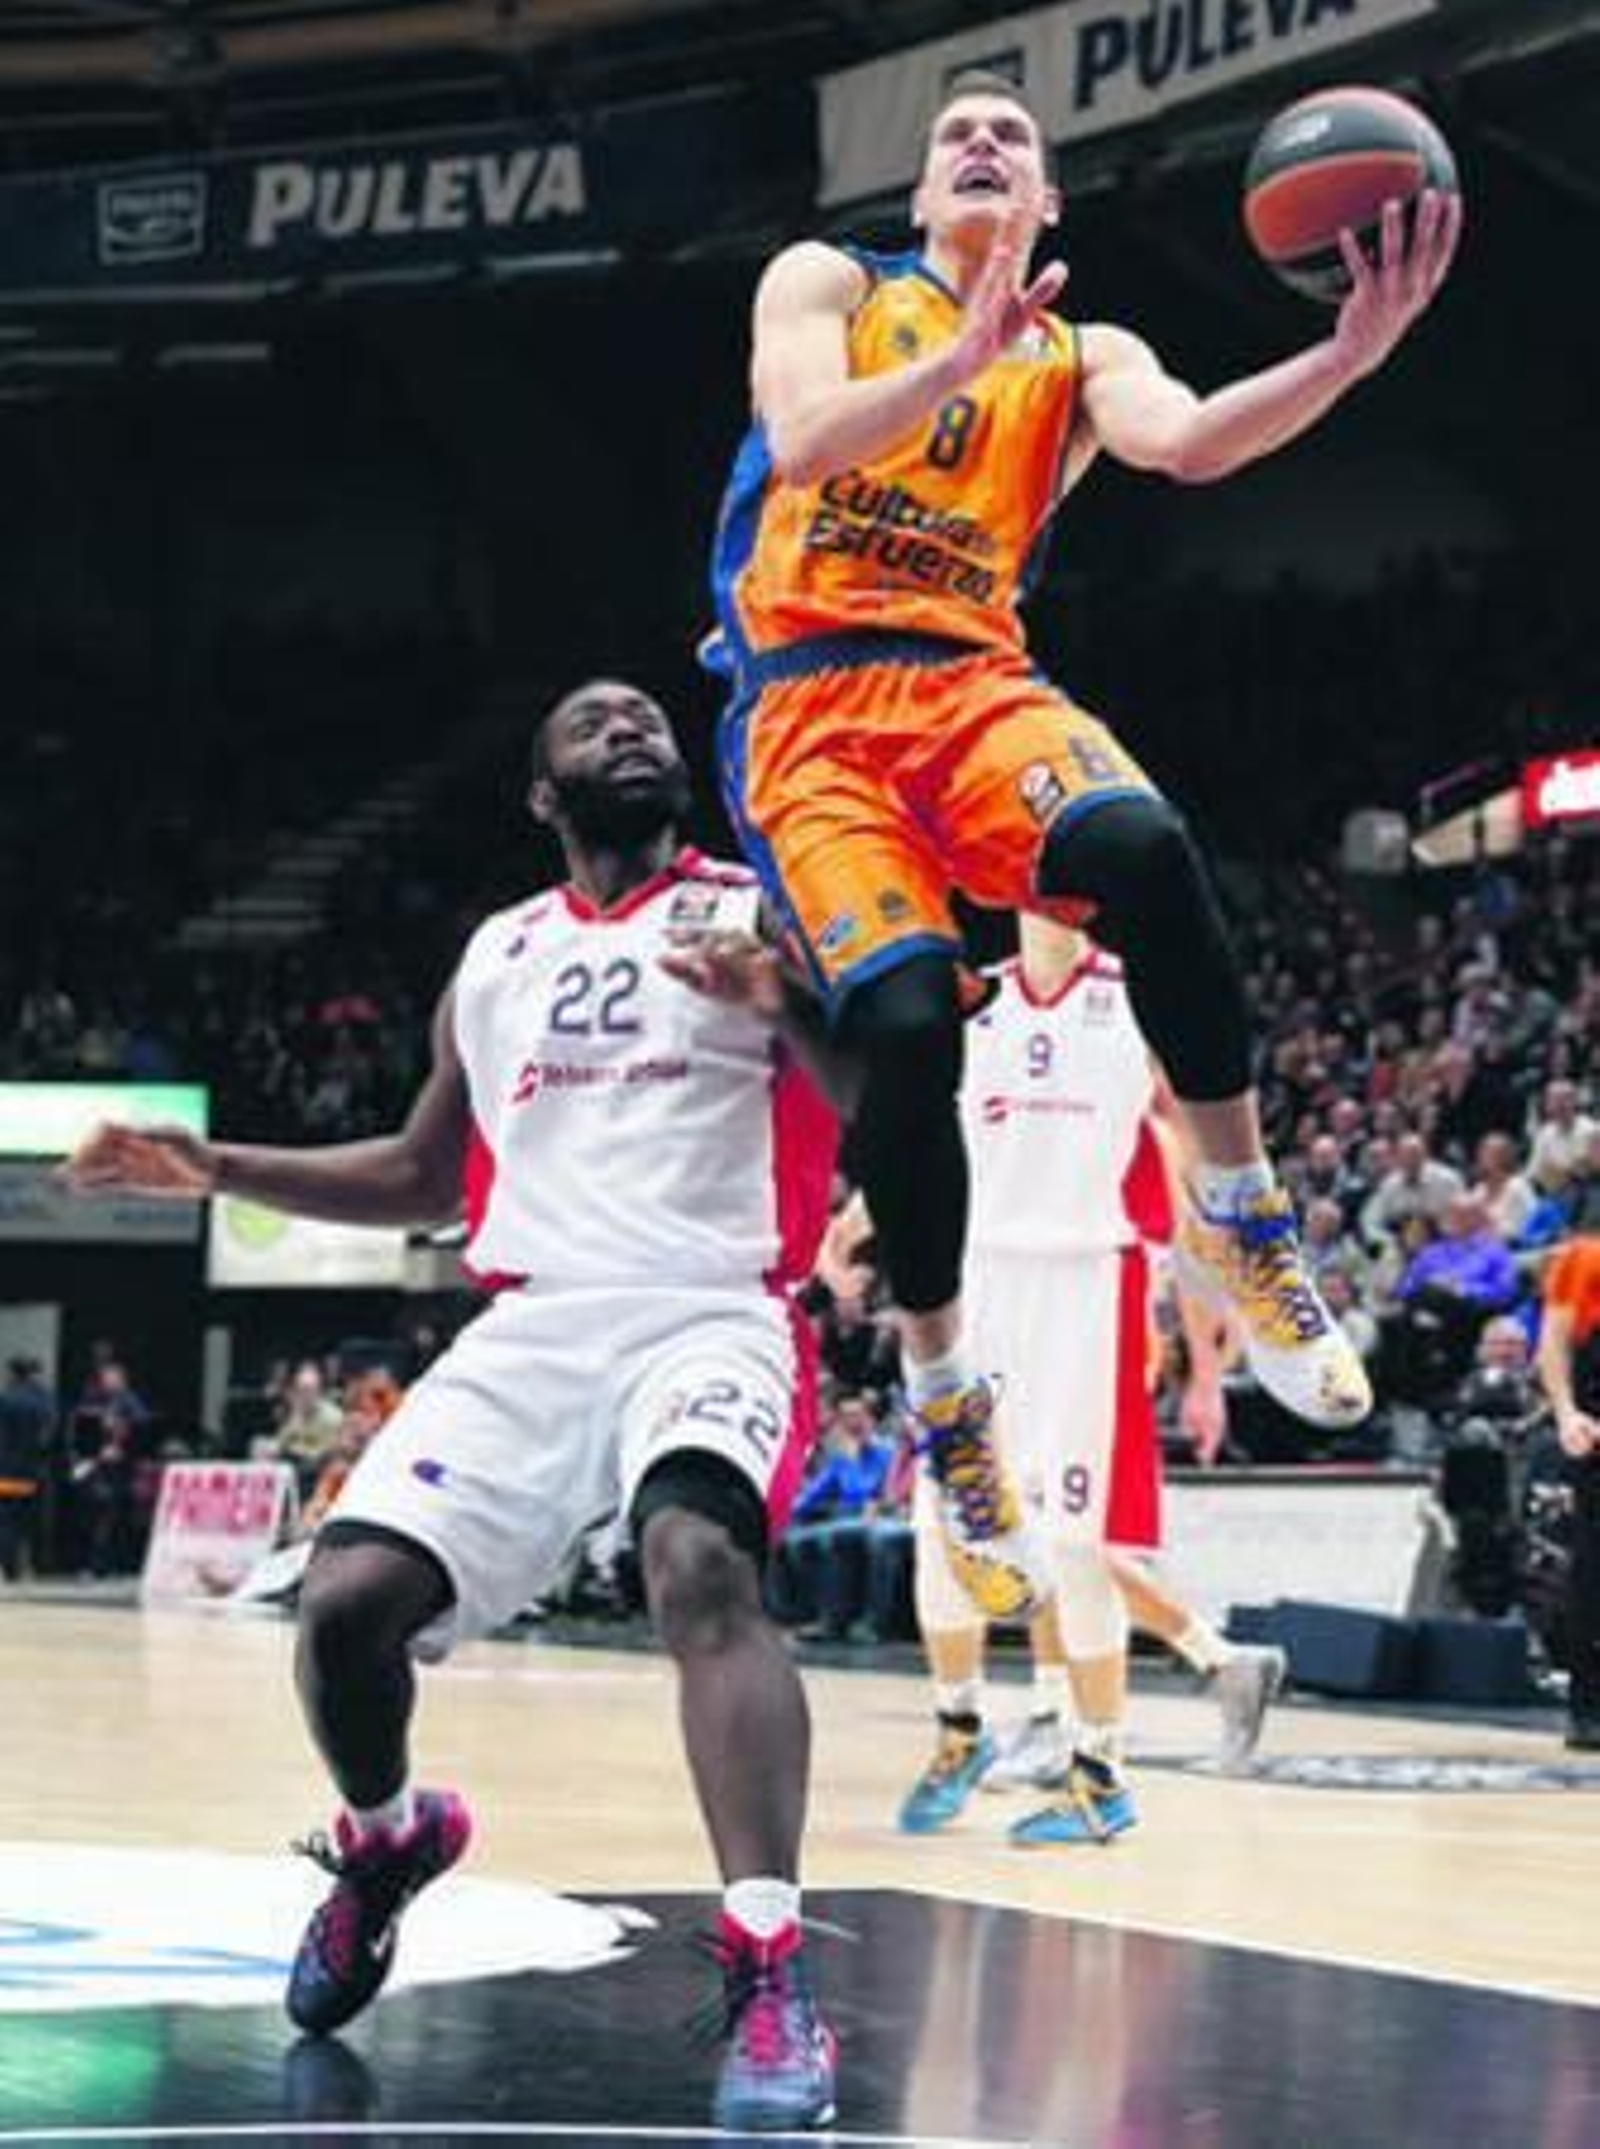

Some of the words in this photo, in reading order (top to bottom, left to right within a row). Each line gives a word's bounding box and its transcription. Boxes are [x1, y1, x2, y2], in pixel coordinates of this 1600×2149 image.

[247, 145, 587, 246] PULEVA
[925, 395, 976, 471] 8
[548, 957, 641, 1036] 22
[1029, 1033, 1052, 1078] 9
[686, 1378, 781, 1465] 22
[1063, 1465, 1089, 1513] 9
